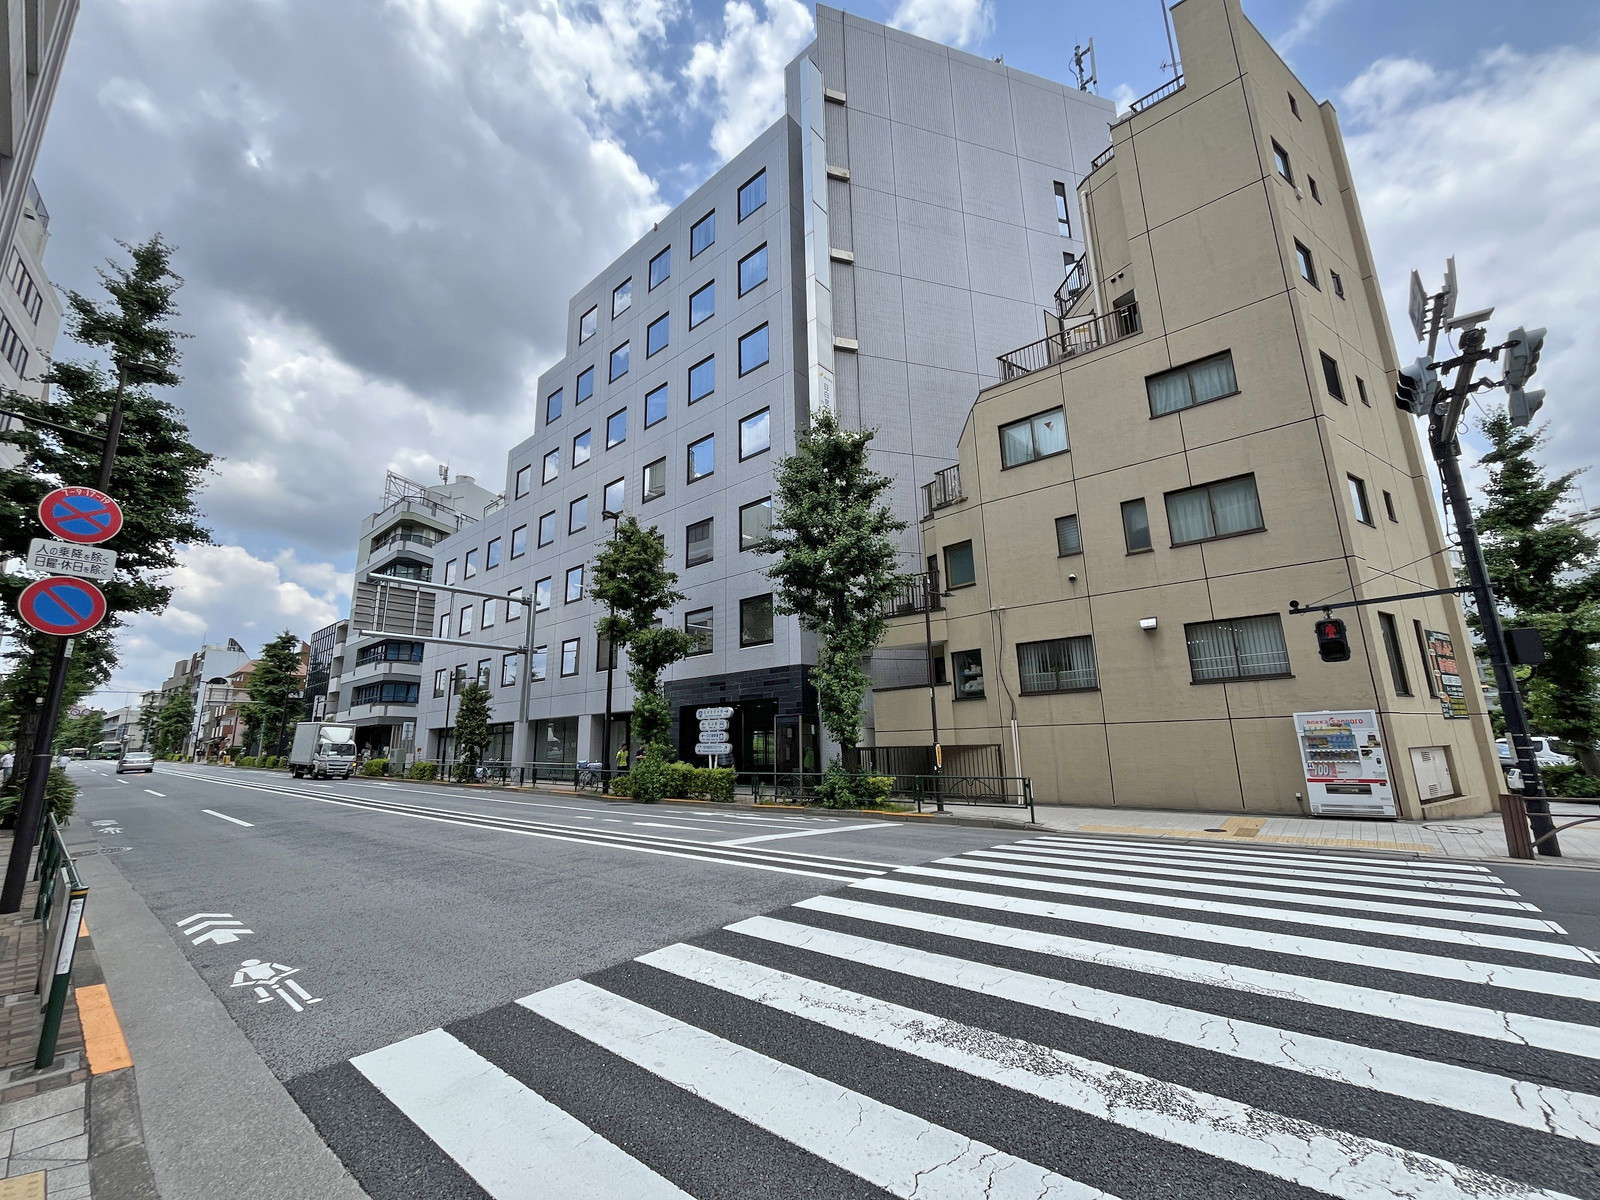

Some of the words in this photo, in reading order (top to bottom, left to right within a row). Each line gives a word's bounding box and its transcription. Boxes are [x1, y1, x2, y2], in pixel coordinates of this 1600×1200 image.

[36, 543, 109, 563] 人の乗降を除く
[34, 556, 107, 575] 日曜・休日を除く
